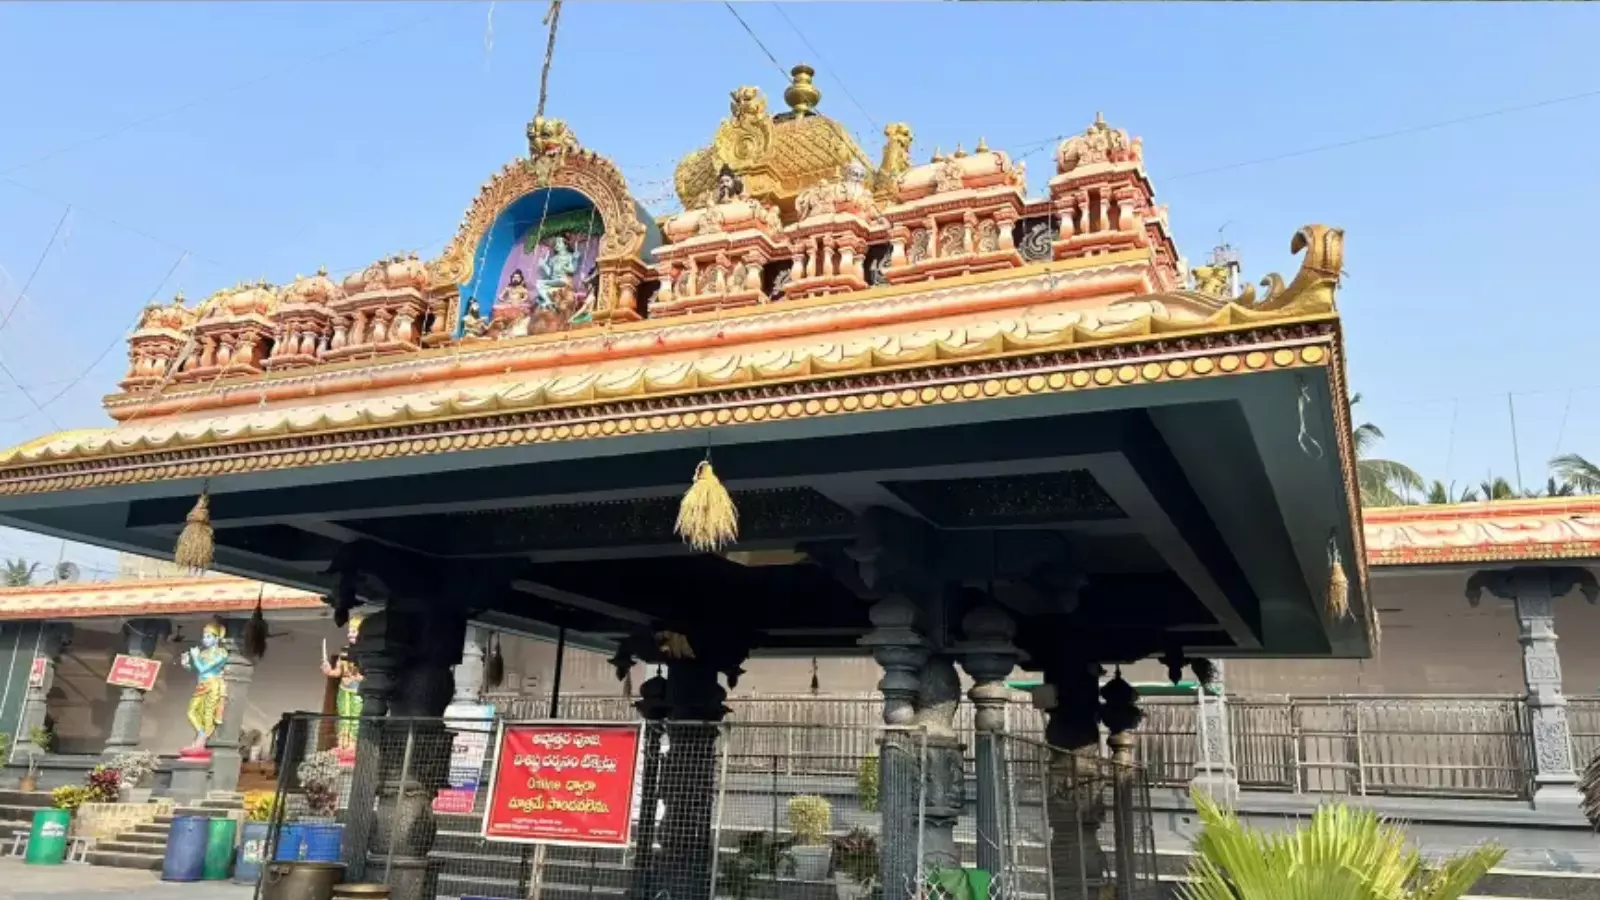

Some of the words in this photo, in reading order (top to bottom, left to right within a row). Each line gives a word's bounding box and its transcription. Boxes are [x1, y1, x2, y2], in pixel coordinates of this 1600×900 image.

[542, 755, 579, 772] దర్శనం
[527, 777, 561, 790] Online
[566, 780, 596, 796] ద్వారా
[509, 794, 544, 812] మాత్రమే
